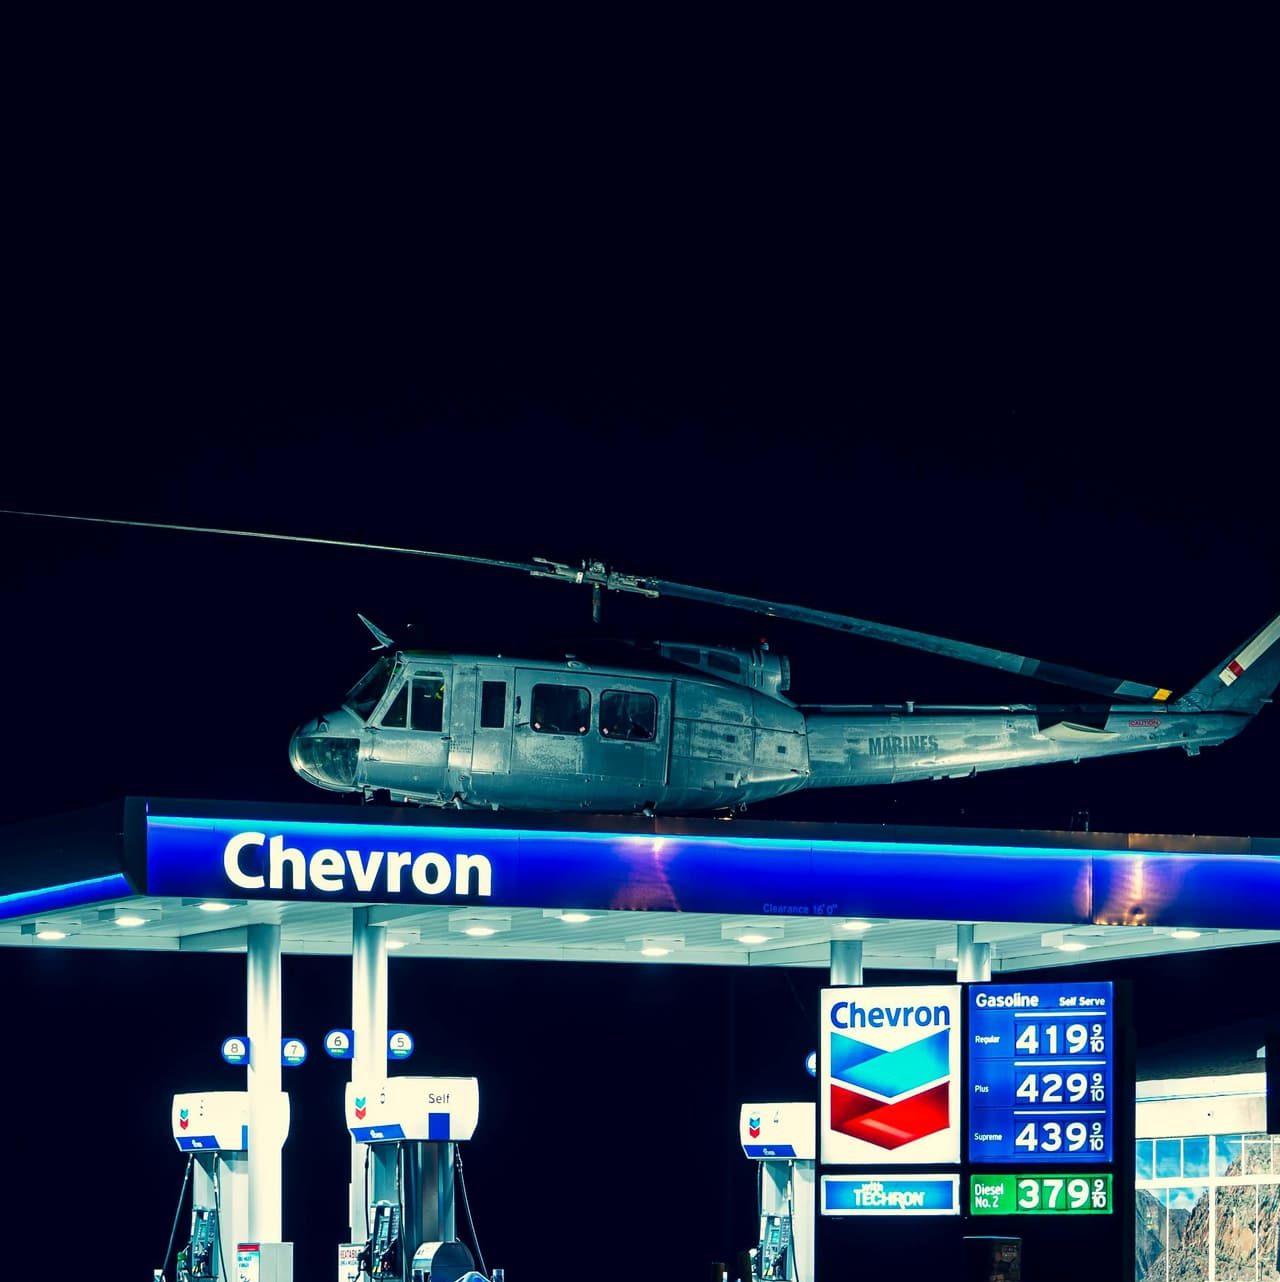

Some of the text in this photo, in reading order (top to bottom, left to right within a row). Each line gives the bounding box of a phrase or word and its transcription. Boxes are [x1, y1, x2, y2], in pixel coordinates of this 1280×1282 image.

[868, 735, 939, 755] MARINES
[224, 832, 492, 897] Chevron
[763, 903, 809, 914] Clearance
[976, 993, 1106, 1007] Gasoline Self Serve
[830, 1001, 951, 1029] Chevron
[334, 1036, 342, 1046] 6
[397, 1038, 405, 1048] 5
[975, 1035, 1001, 1046] Regular
[1016, 1024, 1087, 1054] 419
[230, 1043, 239, 1053] 8
[290, 1045, 298, 1055] 7
[974, 1084, 989, 1093] Plus
[1016, 1073, 1087, 1102] 429
[428, 1093, 450, 1104] Self
[974, 1132, 1002, 1142] Supreme
[1015, 1122, 1087, 1152] 439
[853, 1188, 925, 1209] TECHRON
[974, 1183, 1004, 1196] Diesel
[1019, 1179, 1089, 1209] 379
[975, 1196, 999, 1209] No. 2
